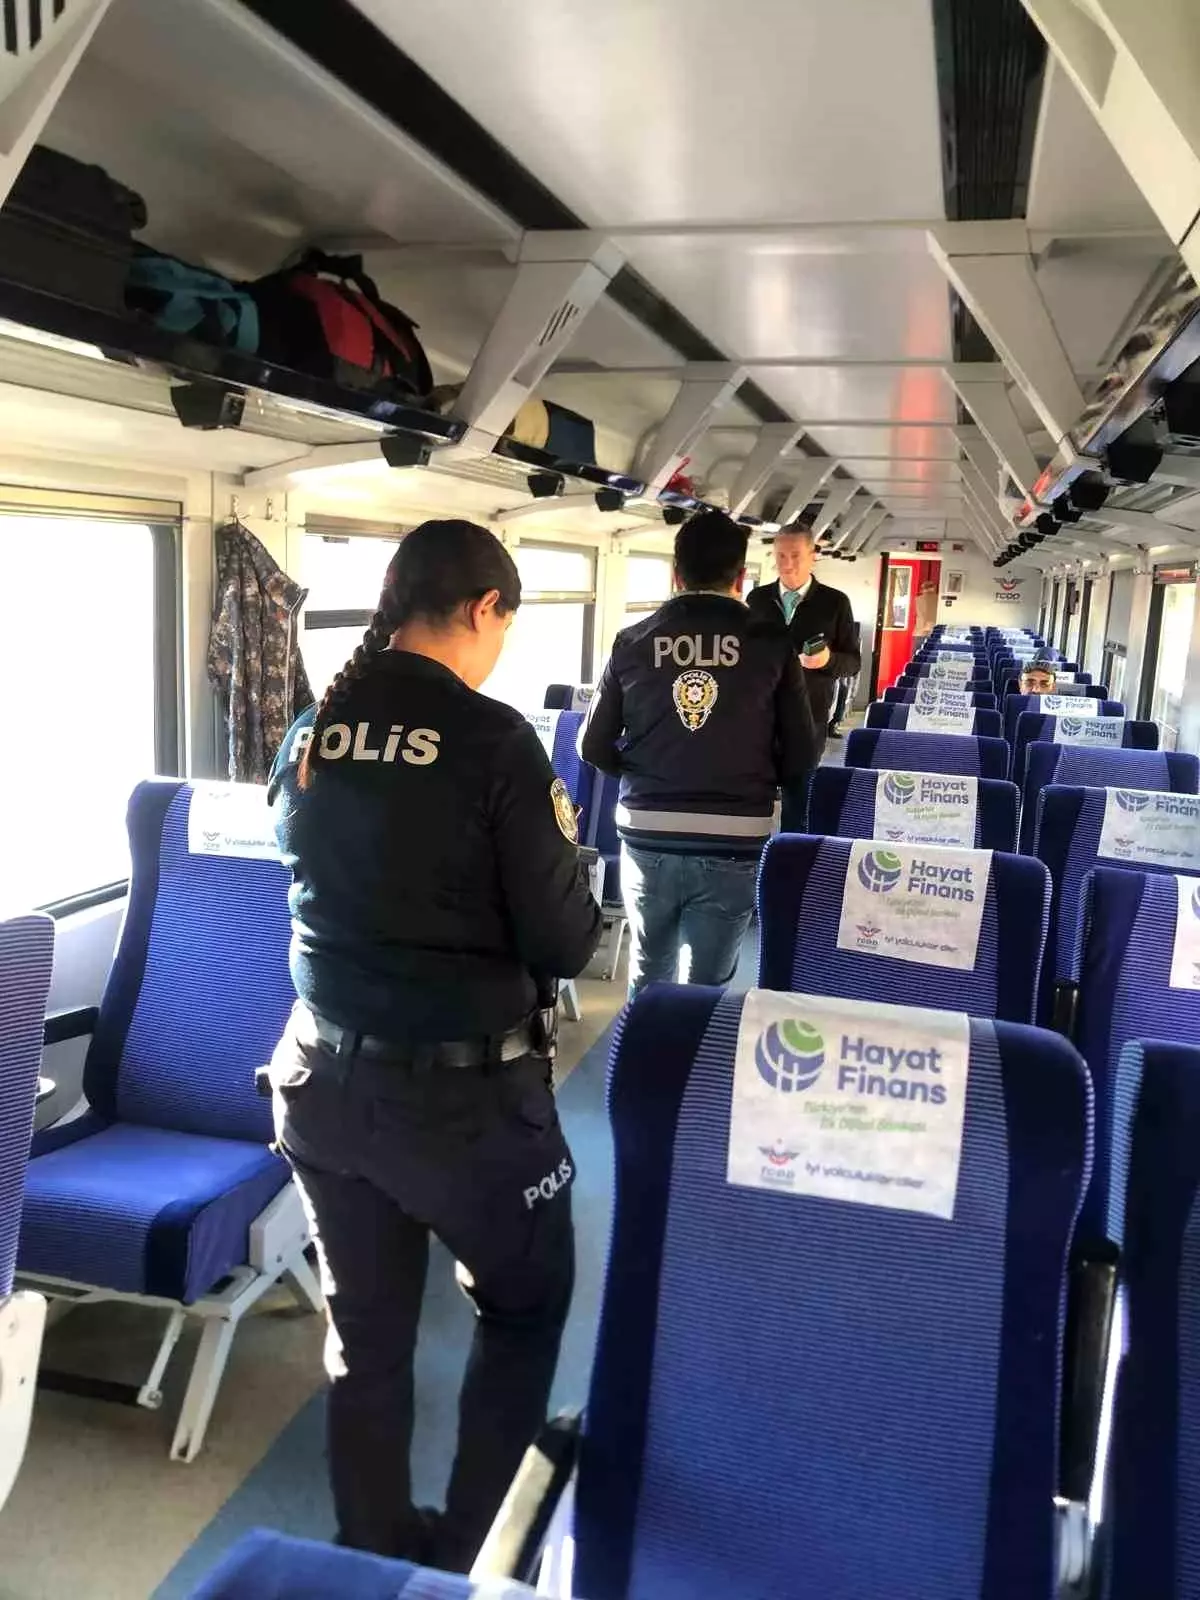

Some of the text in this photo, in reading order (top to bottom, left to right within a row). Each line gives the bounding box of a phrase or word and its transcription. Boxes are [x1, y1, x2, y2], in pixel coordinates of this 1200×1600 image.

[653, 634, 740, 668] POLIS
[1085, 728, 1117, 739] Finans
[920, 778, 967, 792] Hayat
[920, 790, 969, 805] Finans
[1156, 801, 1200, 817] Finan
[910, 859, 973, 883] Hayat
[907, 876, 975, 902] Finans
[840, 1034, 942, 1074] Hayat
[837, 1065, 948, 1105] Finans
